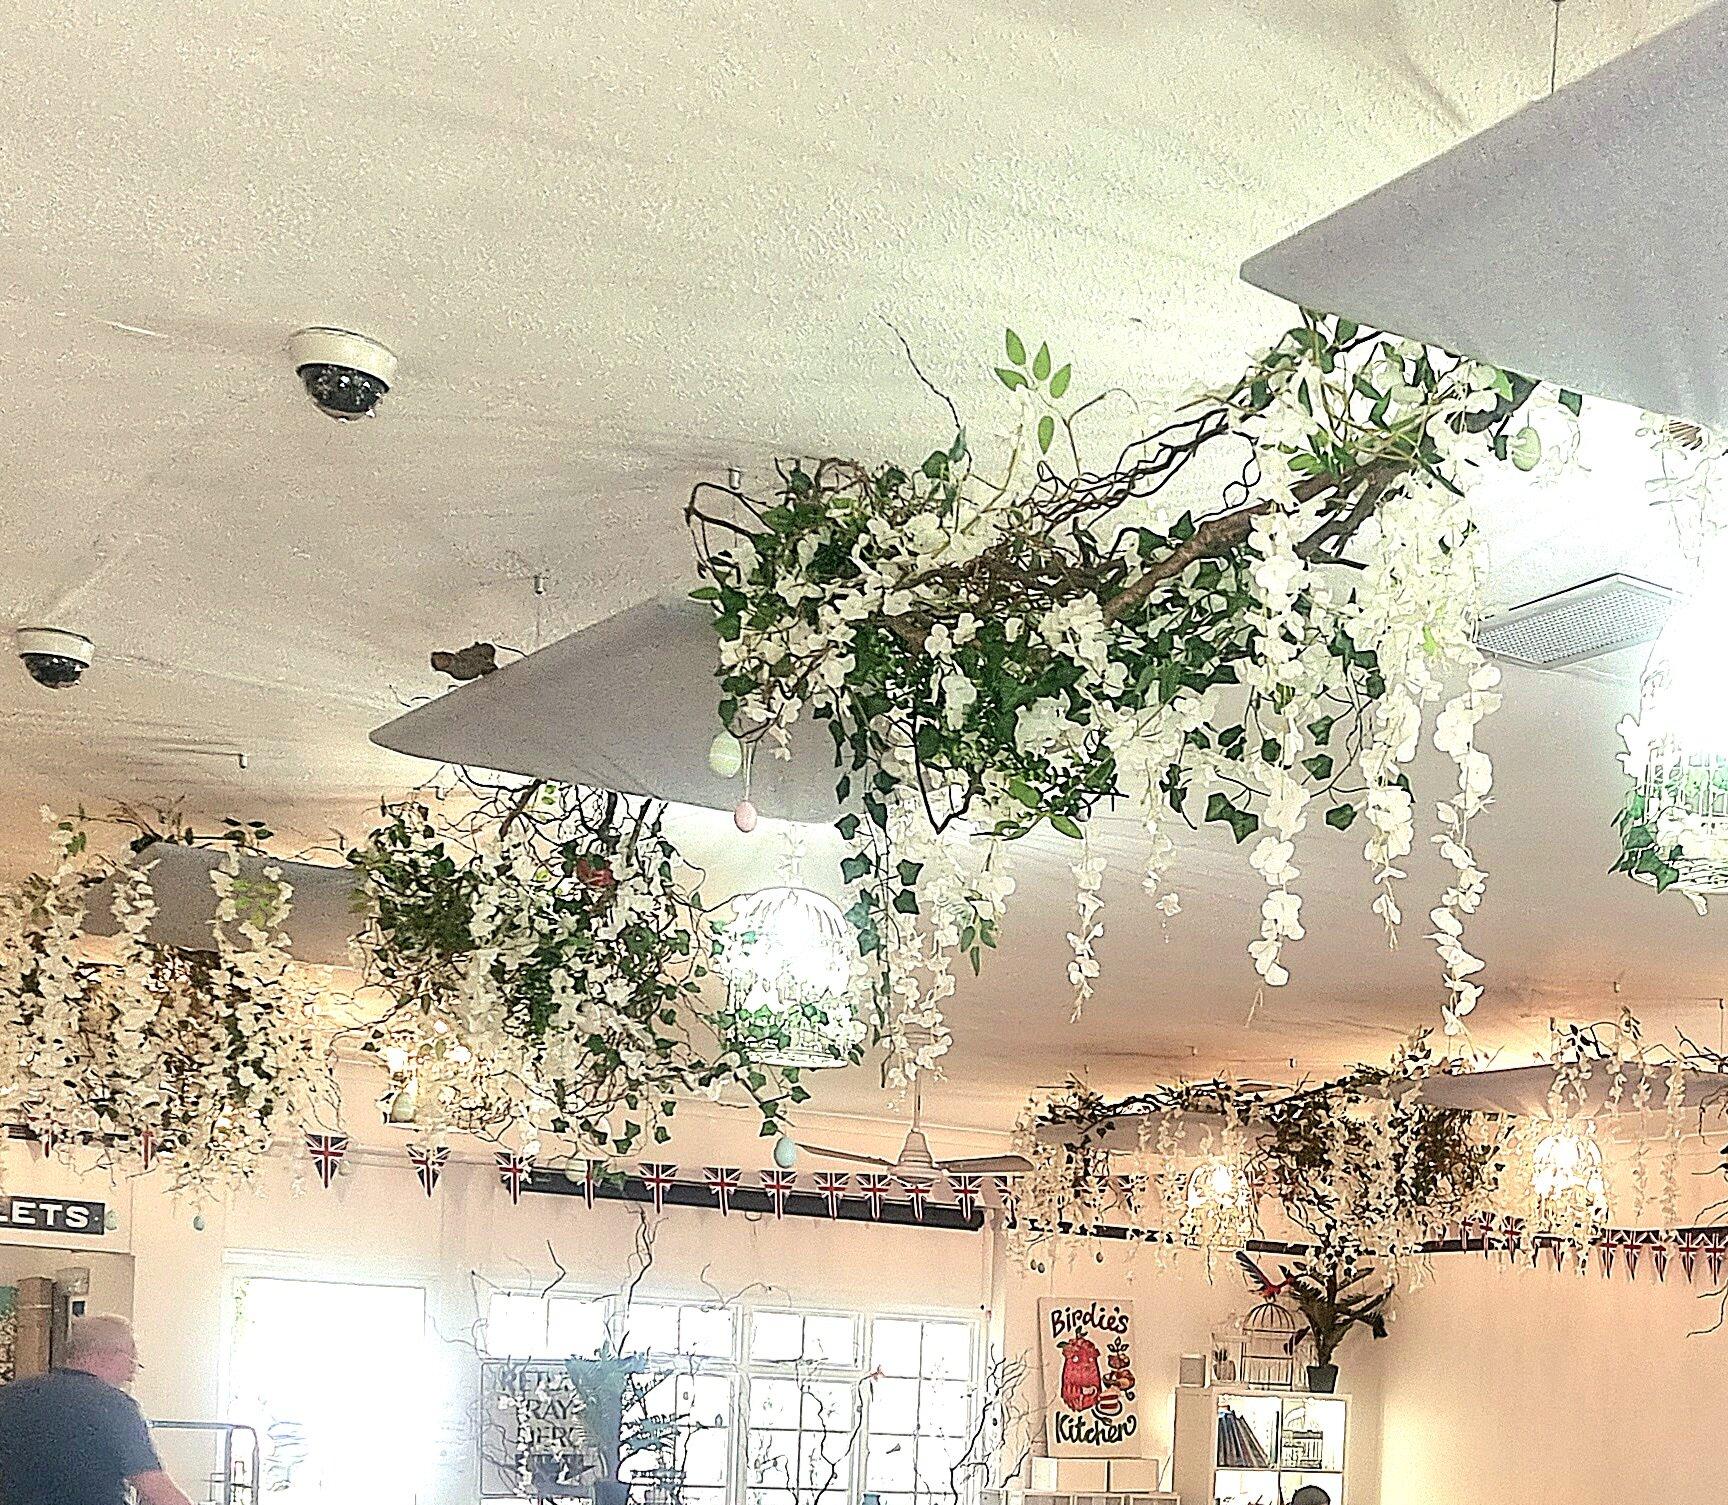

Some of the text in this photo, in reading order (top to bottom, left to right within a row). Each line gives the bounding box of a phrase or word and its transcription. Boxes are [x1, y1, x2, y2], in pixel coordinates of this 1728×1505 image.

[0, 1200, 90, 1229] ETS
[1051, 1301, 1129, 1338] Birdie's
[1055, 1411, 1137, 1446] Kitchen
